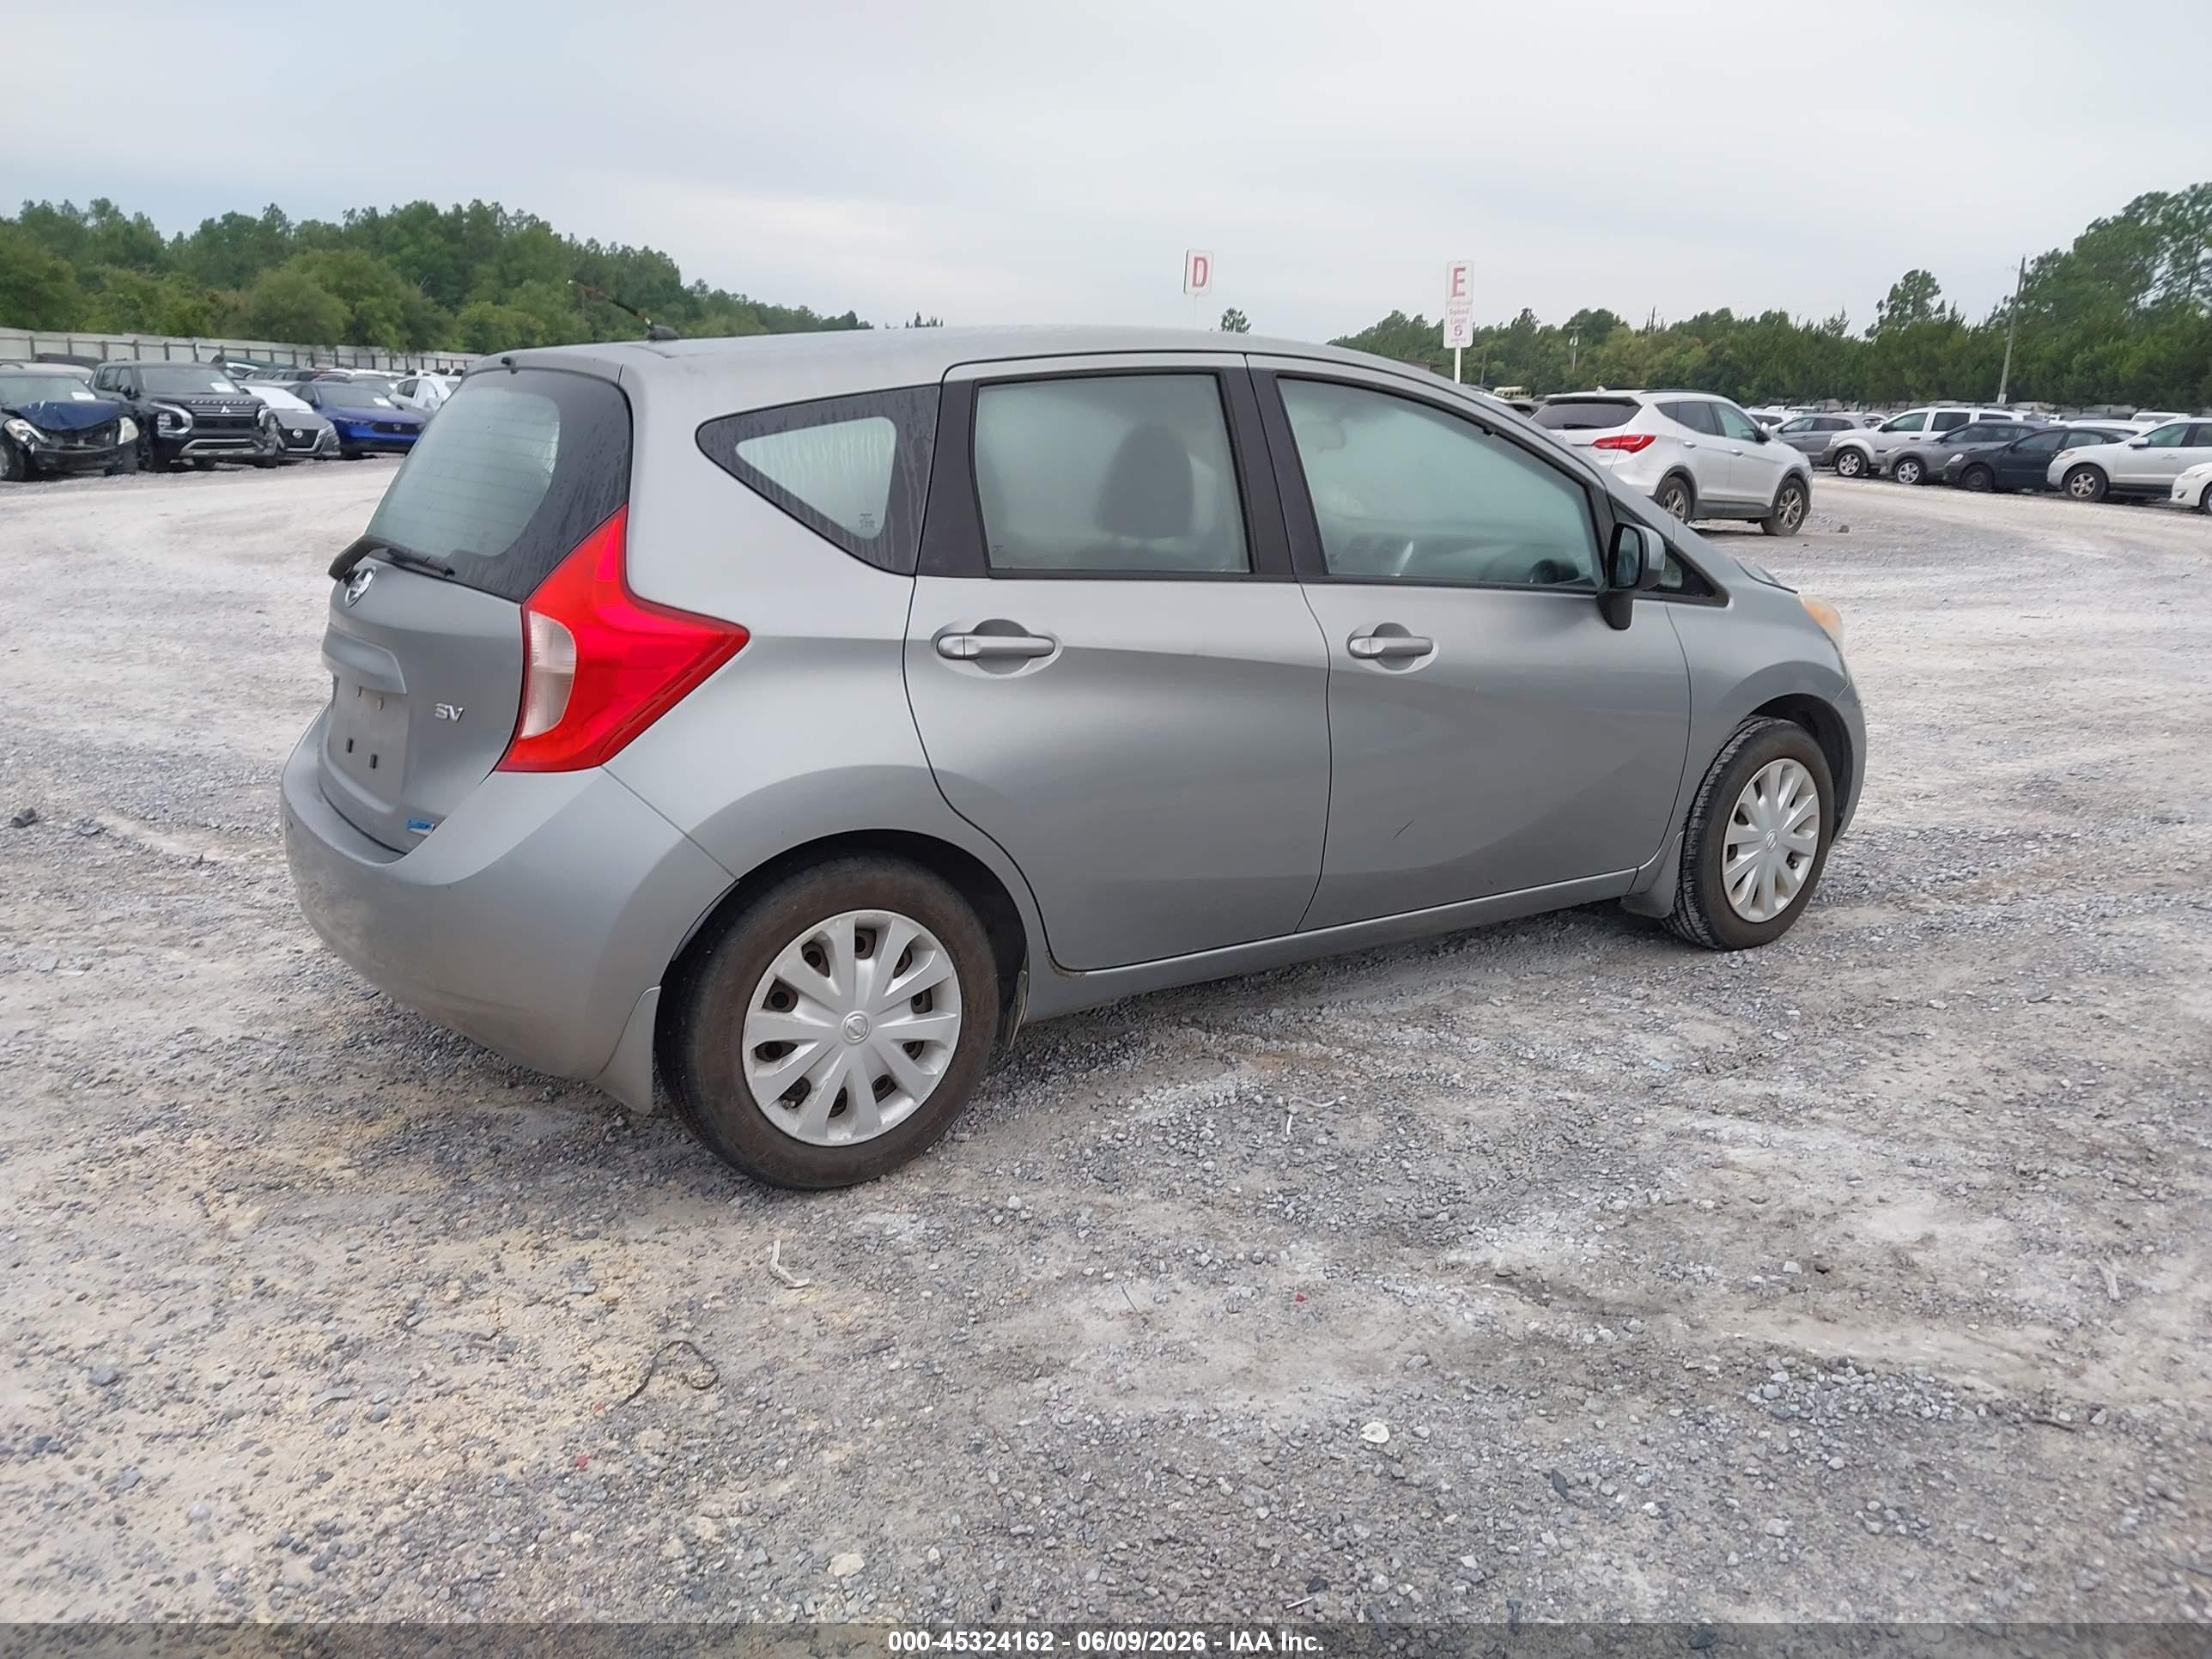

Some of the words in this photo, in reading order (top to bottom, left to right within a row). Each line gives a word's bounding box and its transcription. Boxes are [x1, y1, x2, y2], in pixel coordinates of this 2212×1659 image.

[1192, 257, 1208, 288] D
[1450, 267, 1466, 298] E
[1454, 324, 1463, 337] 5
[434, 702, 465, 722] SV
